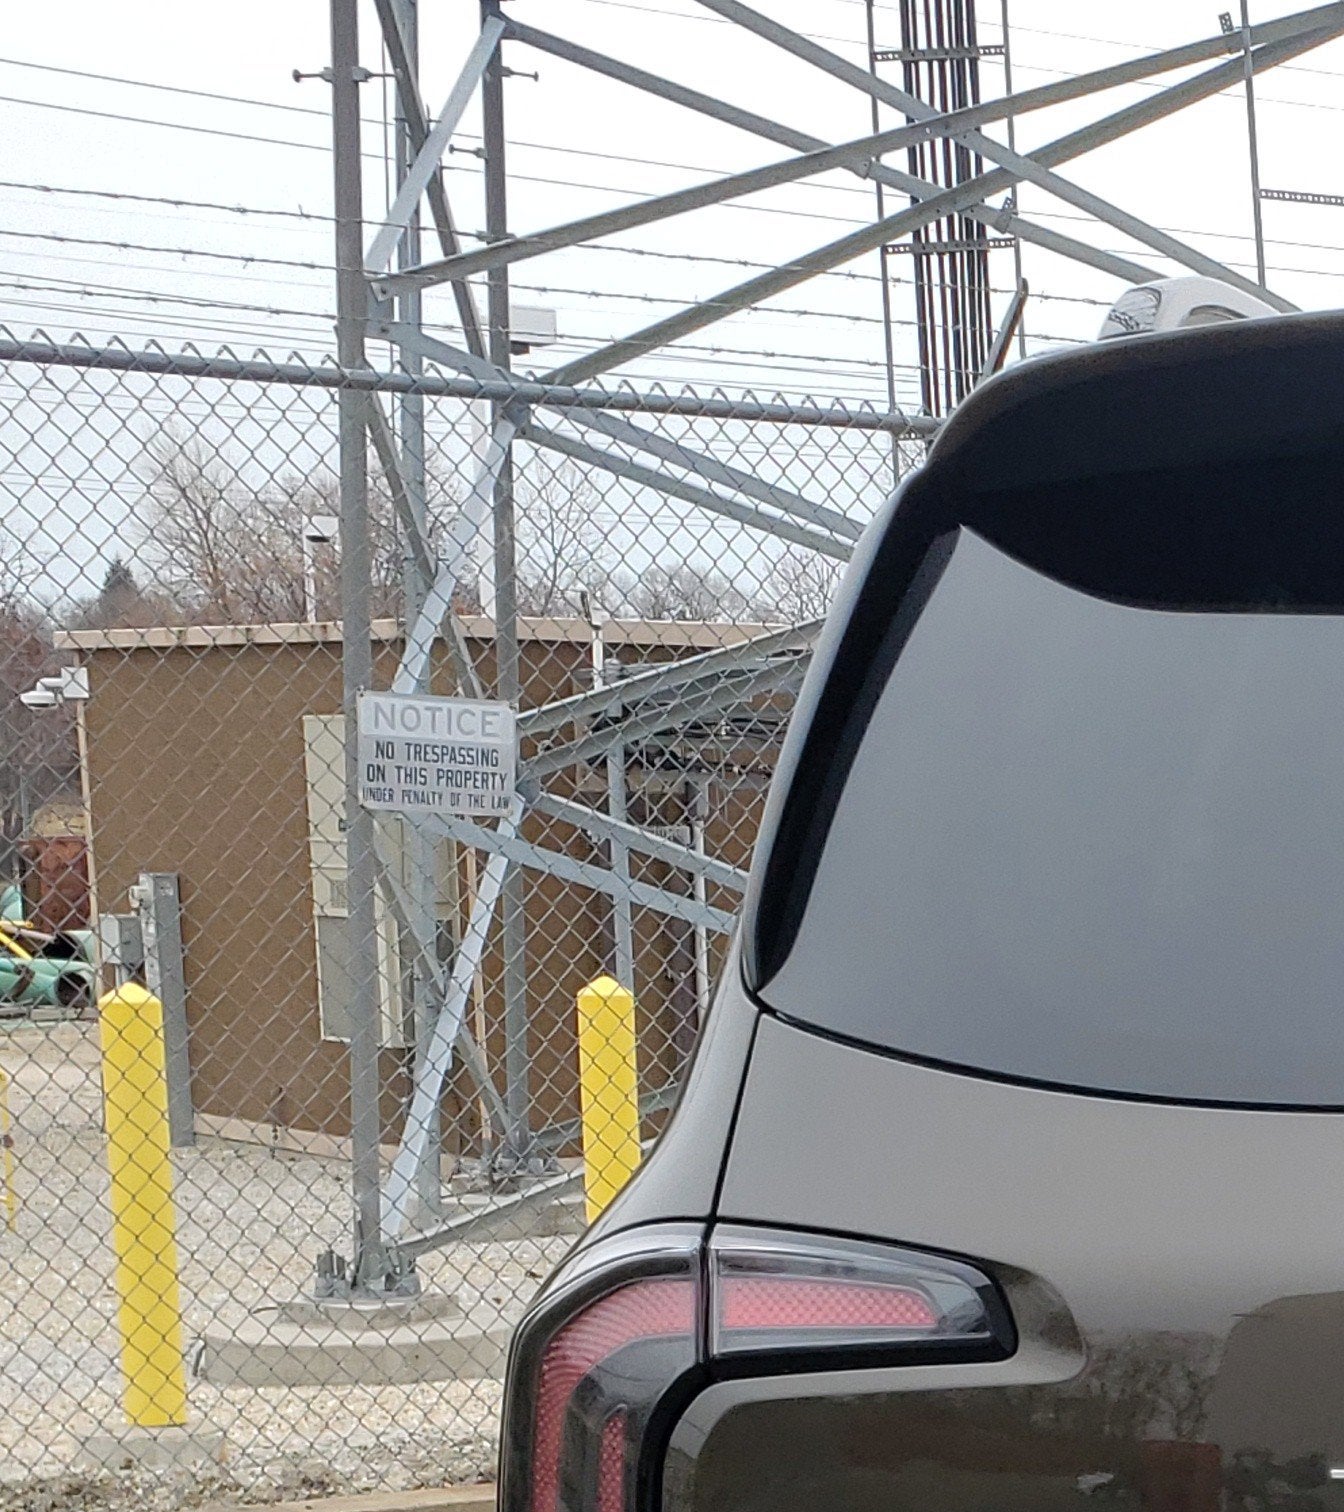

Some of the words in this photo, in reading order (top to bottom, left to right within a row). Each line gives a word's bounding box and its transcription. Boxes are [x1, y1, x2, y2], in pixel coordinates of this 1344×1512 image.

[373, 702, 500, 738] NOTICE
[375, 740, 395, 760] NO
[405, 742, 499, 768] TRESPASSING
[366, 763, 386, 784] ON
[395, 765, 427, 786] THIS
[436, 768, 508, 791] PROPERTY
[362, 787, 394, 802] UNDER
[402, 789, 443, 806] PENALTY
[450, 793, 461, 807] OF
[468, 793, 485, 809] THE
[491, 796, 509, 810] LAW
